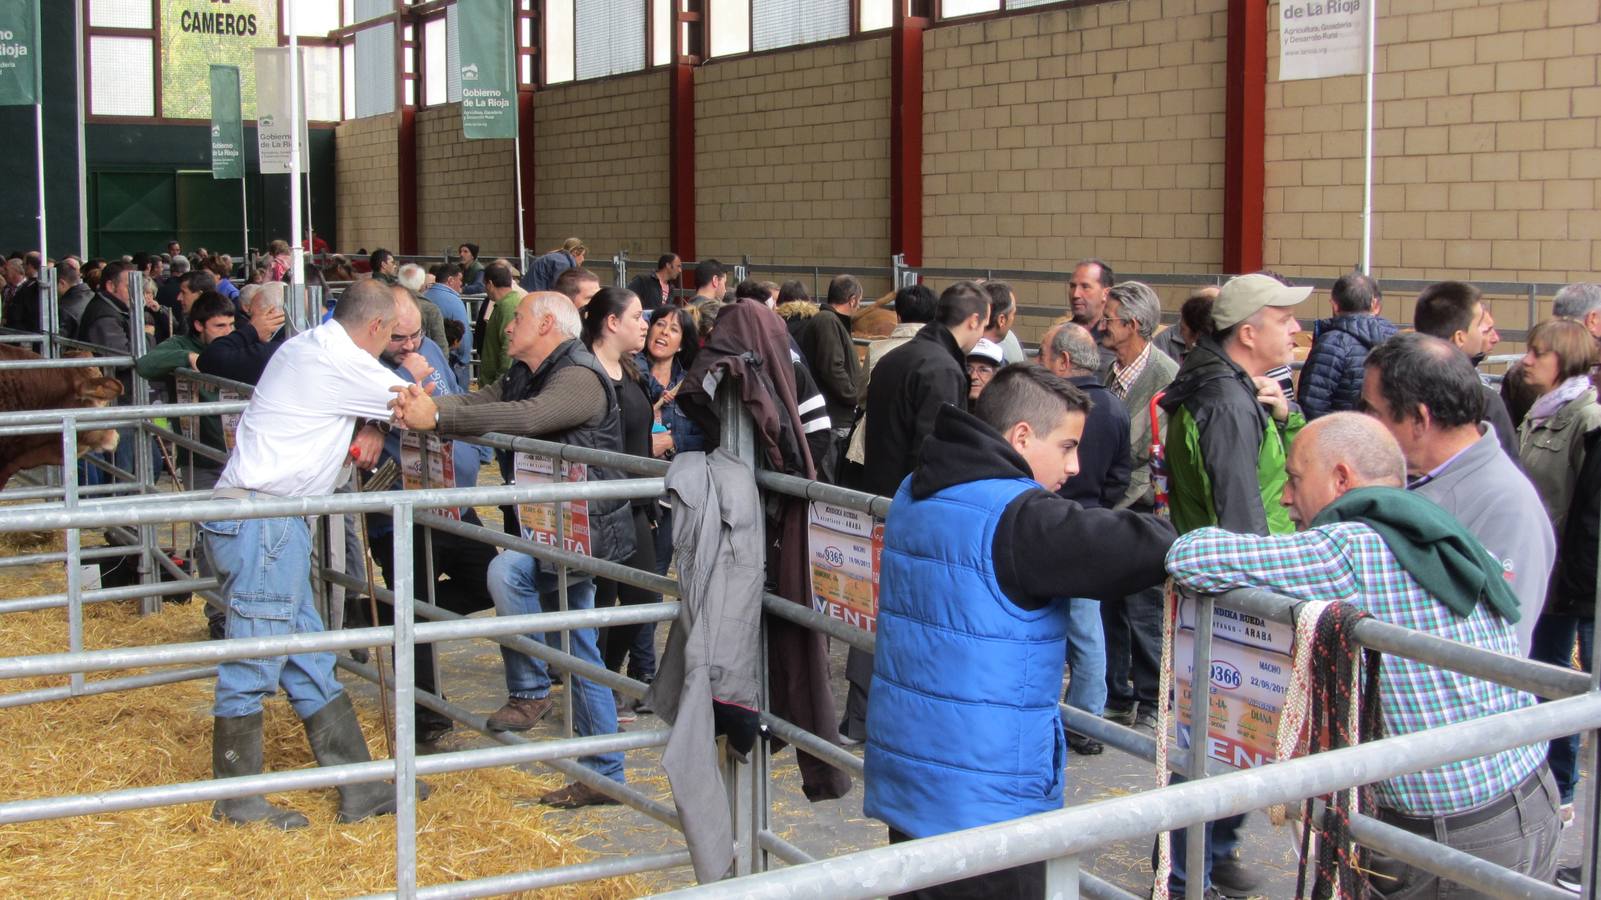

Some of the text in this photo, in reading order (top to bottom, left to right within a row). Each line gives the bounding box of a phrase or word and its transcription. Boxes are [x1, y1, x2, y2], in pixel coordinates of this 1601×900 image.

[1284, 0, 1360, 19] de La Rioja
[181, 10, 257, 37] CAMEROS
[0, 43, 28, 58] ioja
[462, 88, 502, 97] Gobierno
[463, 98, 510, 109] de La Rioja
[260, 133, 292, 141] Gobiern
[814, 596, 877, 633] VENT
[1213, 606, 1266, 628] NDIKA RUEDA
[1244, 627, 1273, 643] ARABA
